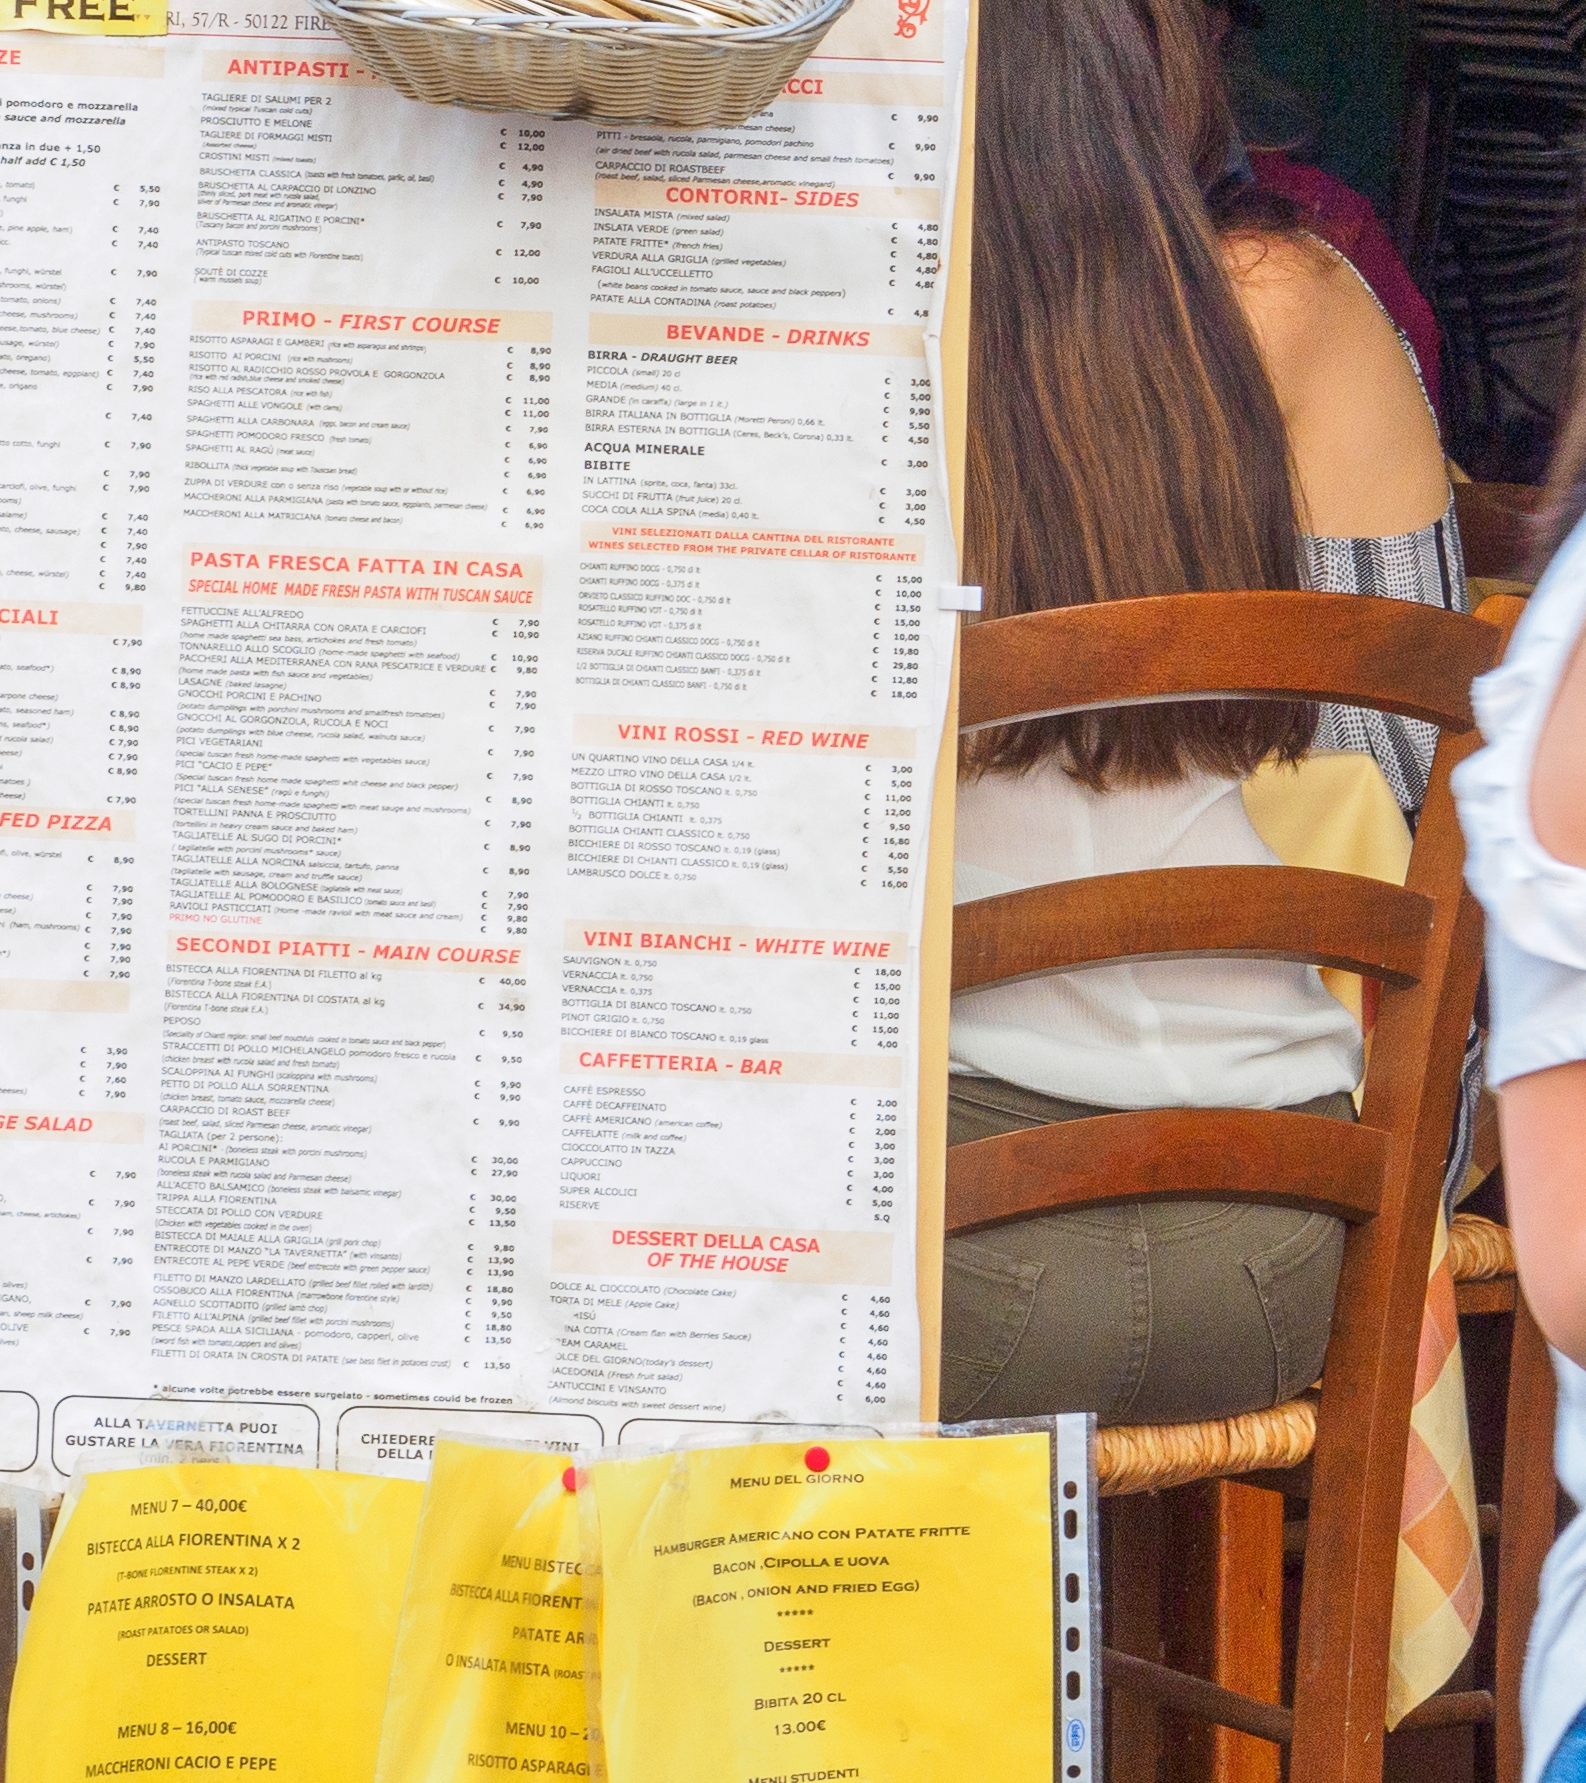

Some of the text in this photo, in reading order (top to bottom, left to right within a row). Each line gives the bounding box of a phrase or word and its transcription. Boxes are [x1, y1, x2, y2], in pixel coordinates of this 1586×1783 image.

[192, 11, 230, 28] 57/R
[244, 13, 288, 30] 50122
[227, 57, 352, 79] ANTIPASTI
[201, 92, 332, 106] TAGLIERE DI SALUMI PER 2
[200, 116, 312, 129] PROSCIUTTO E MELONE
[518, 142, 545, 153] 12,00
[139, 185, 161, 193] 5,50
[665, 186, 860, 208] CONTORNI- SIDES
[242, 310, 501, 334] PRIMO FIRST COURSE
[666, 324, 870, 347] BEVANDE DRINKS
[587, 350, 739, 367] BIRRA DRAUGHT BEER
[584, 442, 705, 456] ACQUA MINERALE
[584, 460, 631, 471] BIBITE
[612, 527, 895, 547] VINI SELEZIONATI DALLA CANTINA DEL RISTORANTE
[190, 551, 524, 579] PASTA FRESCA FATTA IN CASA
[617, 724, 870, 749] VINI ROSSI RED WINE
[46, 814, 112, 832] PIZZA
[176, 936, 521, 964] SECONDI PIATTI MAIN COURSE
[583, 931, 891, 958] VINI BIANCHI WHITE WINE
[579, 1051, 783, 1076] CAFFETTERIA BAR
[23, 1115, 93, 1132] SALAD
[560, 1157, 623, 1168] CAPPUCCINO
[873, 1170, 895, 1179] 3,00
[612, 1229, 821, 1254] DESSERT DELLA CASA
[647, 1251, 790, 1273] OF THE HOUSE
[549, 1281, 661, 1295] DOLCE AL CIOCCOLATO
[94, 1417, 278, 1435] ALLA TAVERNETTA PUOI
[360, 1433, 436, 1446] CHIEDERE
[130, 1498, 248, 1516] MENU 7 40,00€
[87, 1533, 301, 1556] BISTECCA ALLA FIORENTINA X 2
[146, 1651, 208, 1668] DESSERT
[117, 1720, 238, 1739] MENU 8 16,00€
[774, 1719, 827, 1736] 13.00€
[85, 1755, 277, 1778] MACCHERONI CACIO E PEPE
